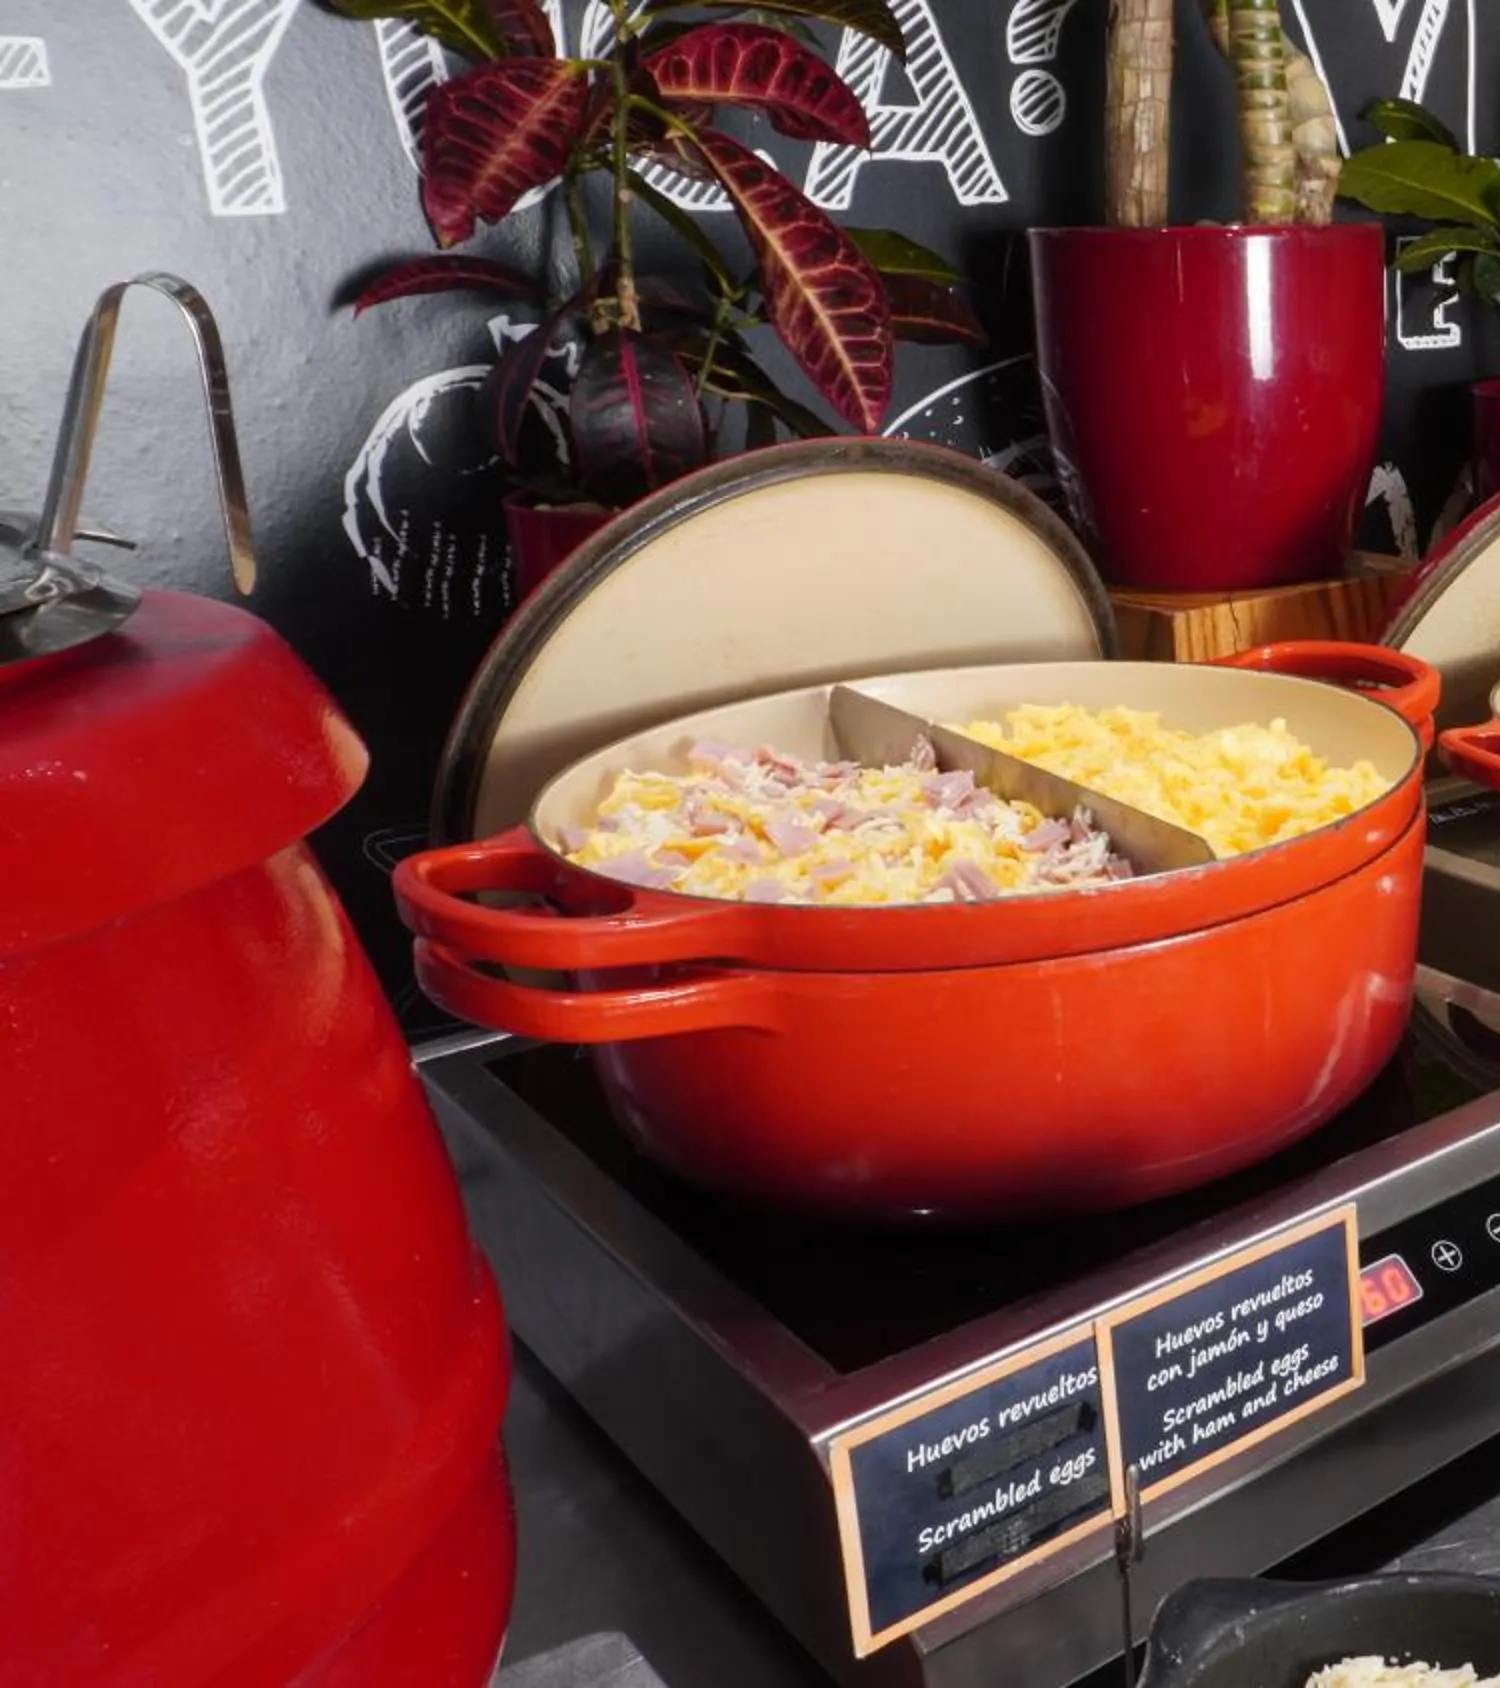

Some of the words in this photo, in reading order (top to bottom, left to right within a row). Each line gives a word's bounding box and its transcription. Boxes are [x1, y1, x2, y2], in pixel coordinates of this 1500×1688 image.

[1147, 1363, 1183, 1392] con
[1186, 1327, 1250, 1379] jamón
[1256, 1318, 1269, 1343] y
[1275, 1293, 1324, 1332] queso
[1155, 1311, 1225, 1358] Huevos
[1231, 1269, 1313, 1321] revueltos
[907, 1417, 990, 1473] Huevos
[999, 1366, 1098, 1428] revueltos
[1139, 1433, 1186, 1471] with
[1192, 1411, 1236, 1445] ham
[1242, 1380, 1277, 1418] and
[1283, 1355, 1339, 1396] cheese
[1163, 1360, 1265, 1433] Scrambled
[1270, 1343, 1309, 1376] eggs
[918, 1469, 1042, 1553] Scrambled
[1050, 1447, 1097, 1485] eggs
